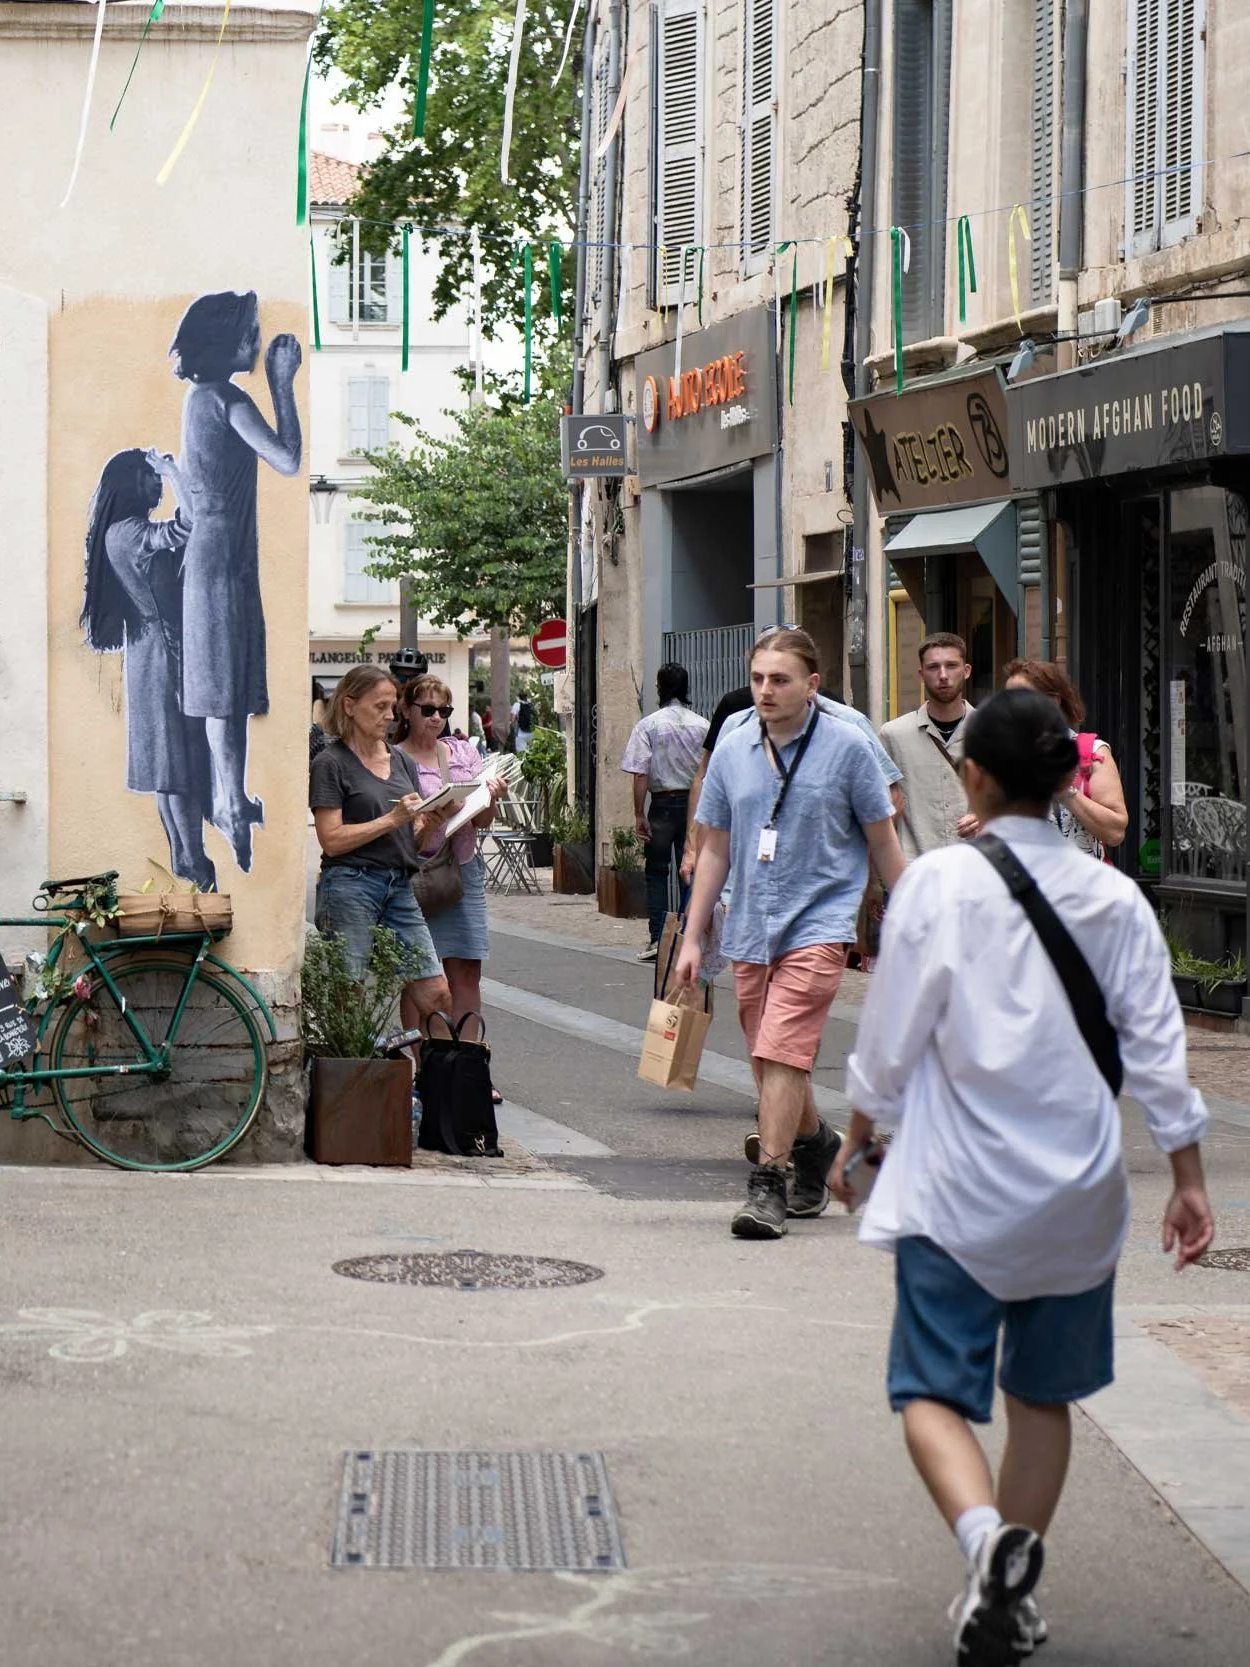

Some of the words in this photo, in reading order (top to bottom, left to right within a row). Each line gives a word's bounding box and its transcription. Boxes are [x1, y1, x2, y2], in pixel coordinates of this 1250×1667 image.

[704, 350, 745, 407] ECOLE
[1026, 408, 1086, 453] MODERN
[1093, 393, 1153, 440] AFGHAN
[1161, 382, 1202, 426] FOOD
[569, 456, 588, 467] Les
[591, 455, 624, 467] Halles
[892, 422, 975, 487] ATELIER
[1179, 561, 1218, 638] RESTAURANT
[1206, 635, 1237, 652] AFGHAN
